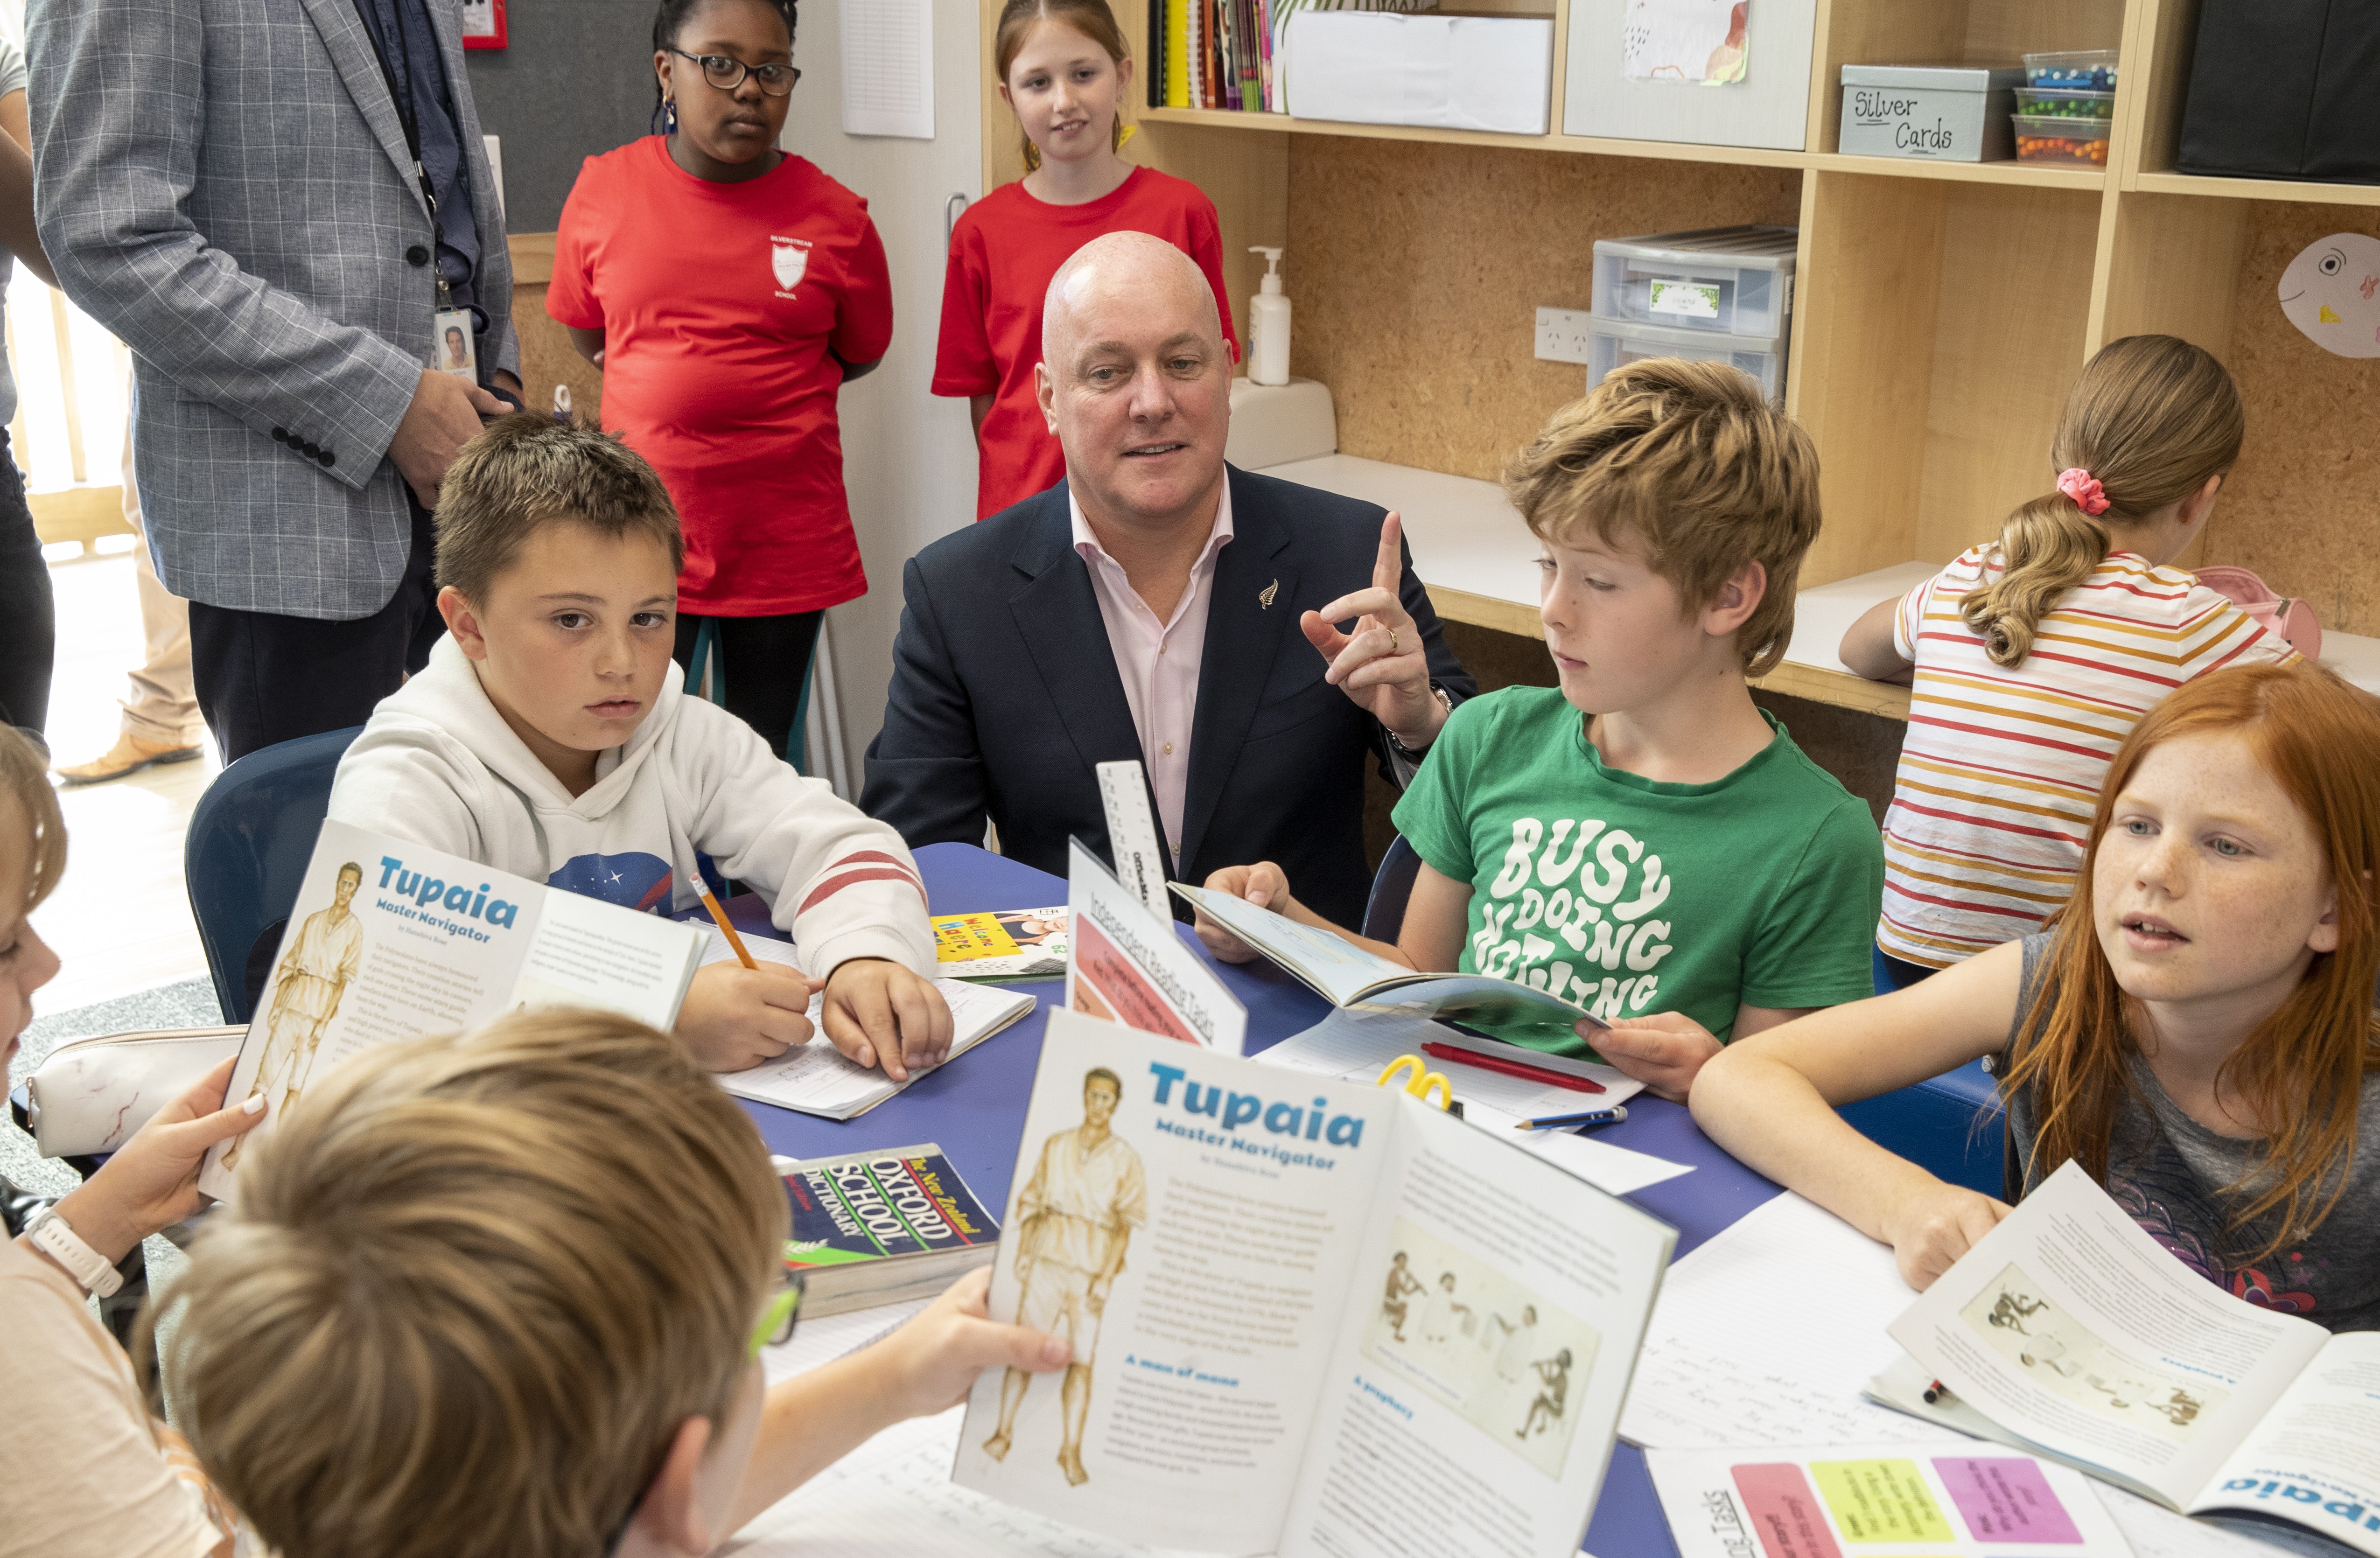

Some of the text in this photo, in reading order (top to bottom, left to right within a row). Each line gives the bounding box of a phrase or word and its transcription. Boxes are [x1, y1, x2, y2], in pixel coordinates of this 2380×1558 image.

[1855, 91, 1917, 119] Silver
[1896, 118, 1952, 148] Cards
[378, 855, 518, 929] Tupaia
[1490, 817, 1671, 921] BUSY
[376, 897, 490, 943] Master Navigator
[938, 921, 972, 949] Haere
[964, 917, 994, 947] Welcome
[1512, 887, 1673, 971] DOING
[1091, 892, 1148, 967] Independent
[1150, 949, 1189, 1013] Reading
[1186, 991, 1215, 1042] Tasks
[1148, 1061, 1366, 1151] Tupaia
[1155, 1117, 1336, 1172] Master Navigator
[802, 1167, 865, 1237] DICTIONARY
[829, 1162, 911, 1246] SCHOOL
[869, 1157, 952, 1240] OXFORD
[908, 1155, 981, 1234] The New Zealand
[1701, 1490, 1738, 1535] Tasks
